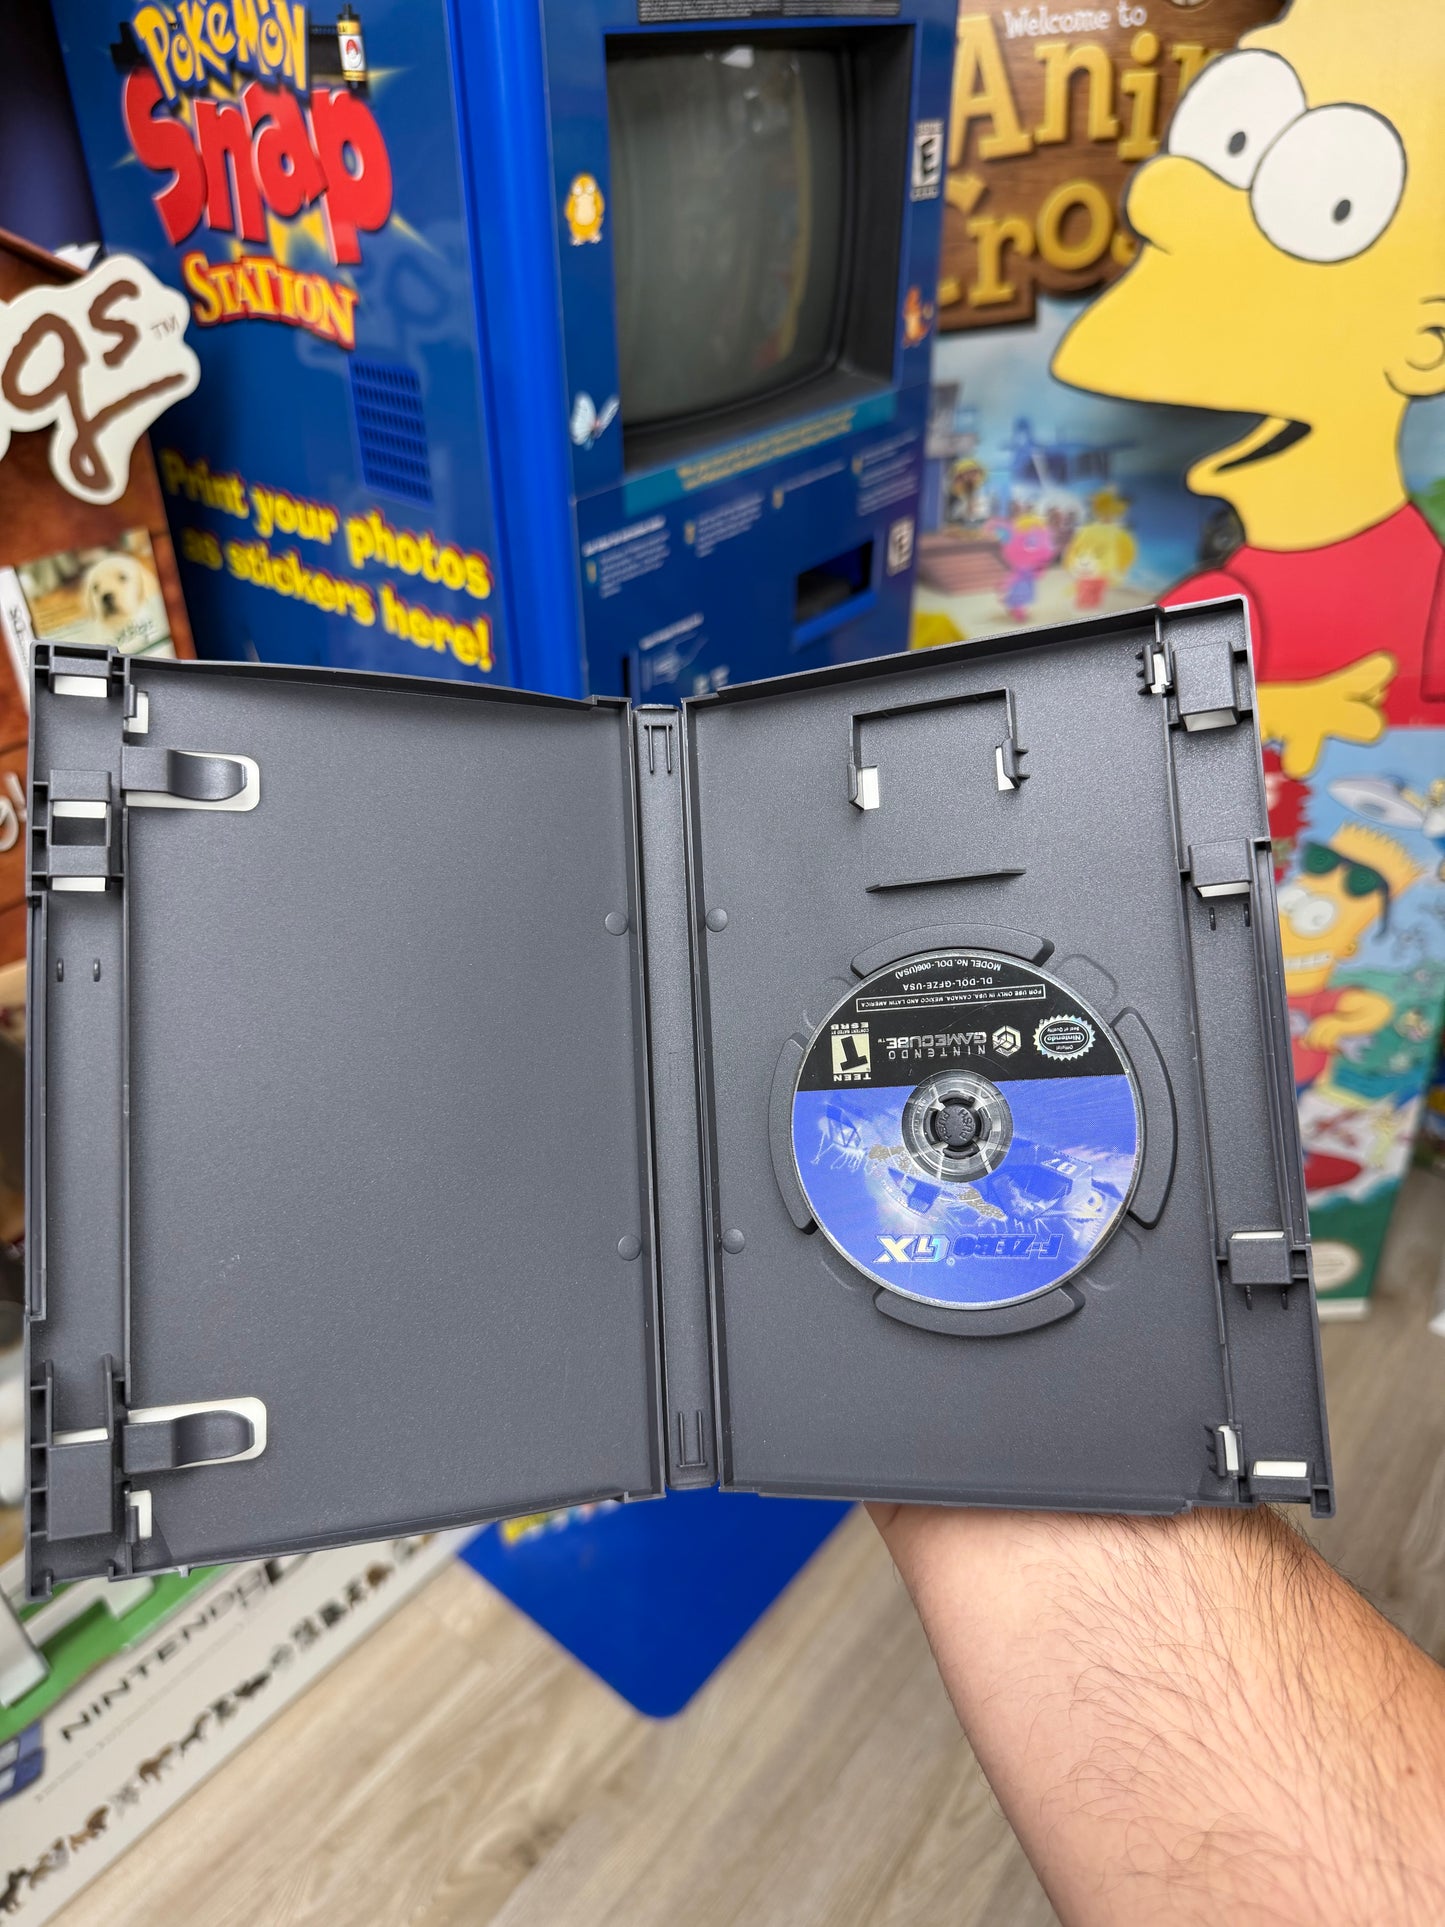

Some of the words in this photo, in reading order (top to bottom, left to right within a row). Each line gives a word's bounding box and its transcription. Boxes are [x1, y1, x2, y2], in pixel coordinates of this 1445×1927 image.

[1003, 6, 1110, 39] Welcome
[1116, 0, 1148, 28] to
[160, 449, 250, 519] Print
[250, 483, 340, 545] your
[344, 506, 494, 600] photos
[182, 526, 223, 570] as
[225, 536, 377, 627] stickers
[378, 579, 495, 672] here!
[954, 959, 969, 967] No.
[970, 959, 1002, 971] MODEL
[902, 976, 993, 991] DL-DOL-GFZE-USA
[861, 1000, 887, 1008] AMERICA
[830, 1021, 869, 1030] ESRB
[1046, 1034, 1081, 1042] Nintendo
[839, 1035, 869, 1072] T
[888, 1044, 986, 1060] NINTENDO
[833, 1072, 872, 1082] TEEN
[872, 1234, 951, 1264] GX
[951, 1234, 1064, 1260] F-ZERO
